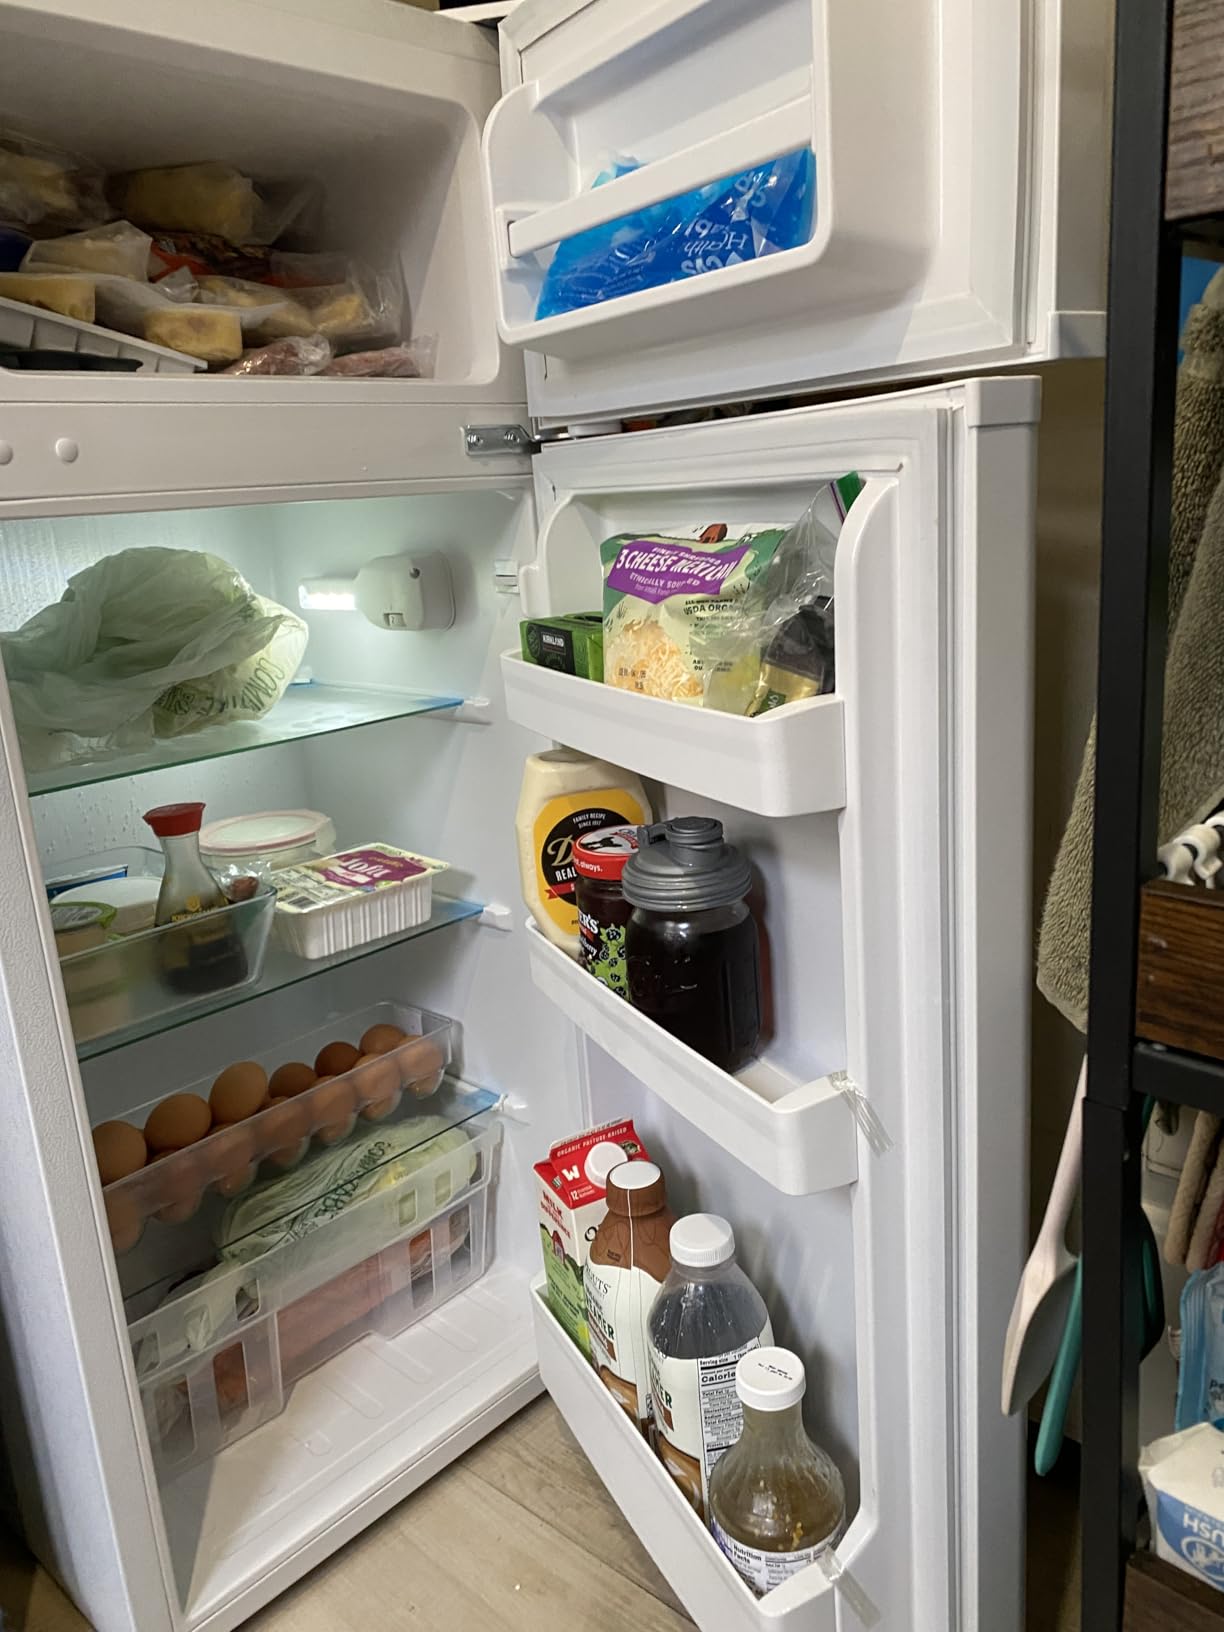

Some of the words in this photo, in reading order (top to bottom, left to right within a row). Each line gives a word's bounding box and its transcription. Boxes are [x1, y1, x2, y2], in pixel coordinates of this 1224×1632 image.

[684, 231, 748, 256] Health
[616, 548, 626, 569] 3
[624, 551, 675, 573] CHEESE
[555, 866, 577, 882] REAL
[556, 1144, 581, 1158] ORGANIC
[701, 1371, 736, 1383] Calorie
[733, 1543, 761, 1561] Nutrition
[733, 1551, 751, 1564] Facts
